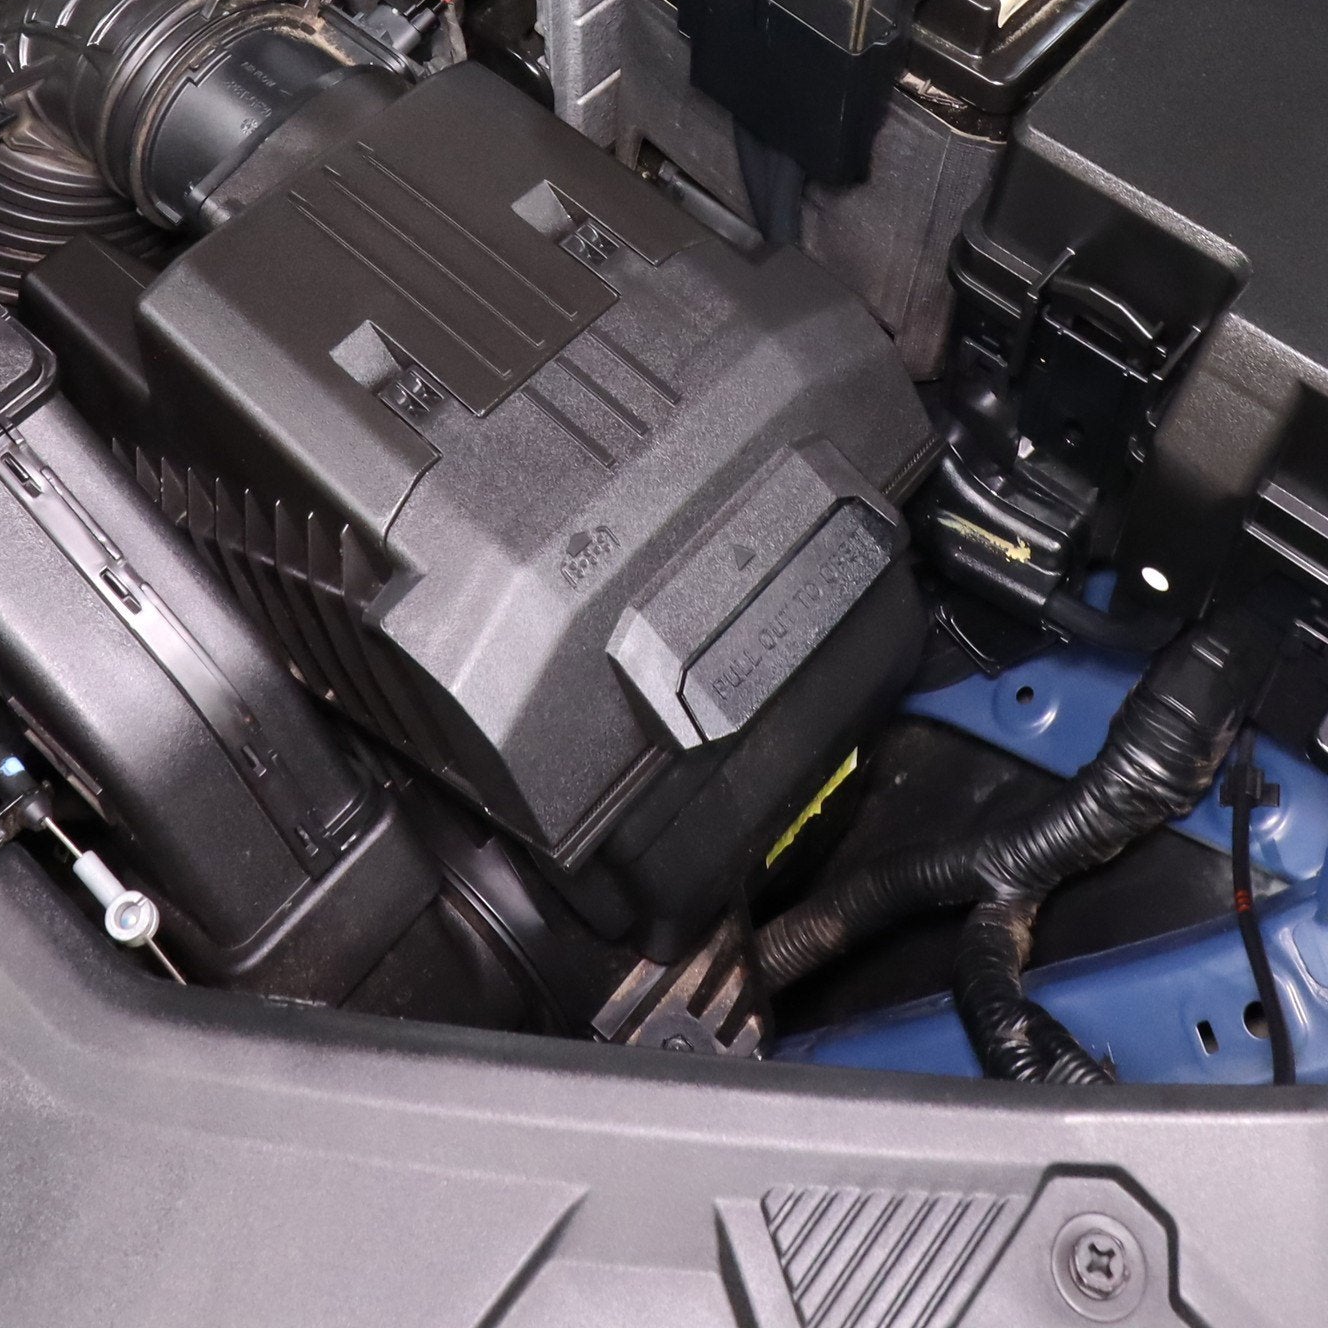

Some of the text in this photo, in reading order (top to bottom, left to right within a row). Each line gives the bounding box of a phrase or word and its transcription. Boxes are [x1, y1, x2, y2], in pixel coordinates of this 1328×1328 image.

[712, 649, 763, 701] PULL
[758, 603, 796, 650] OUT
[791, 582, 822, 609] TO
